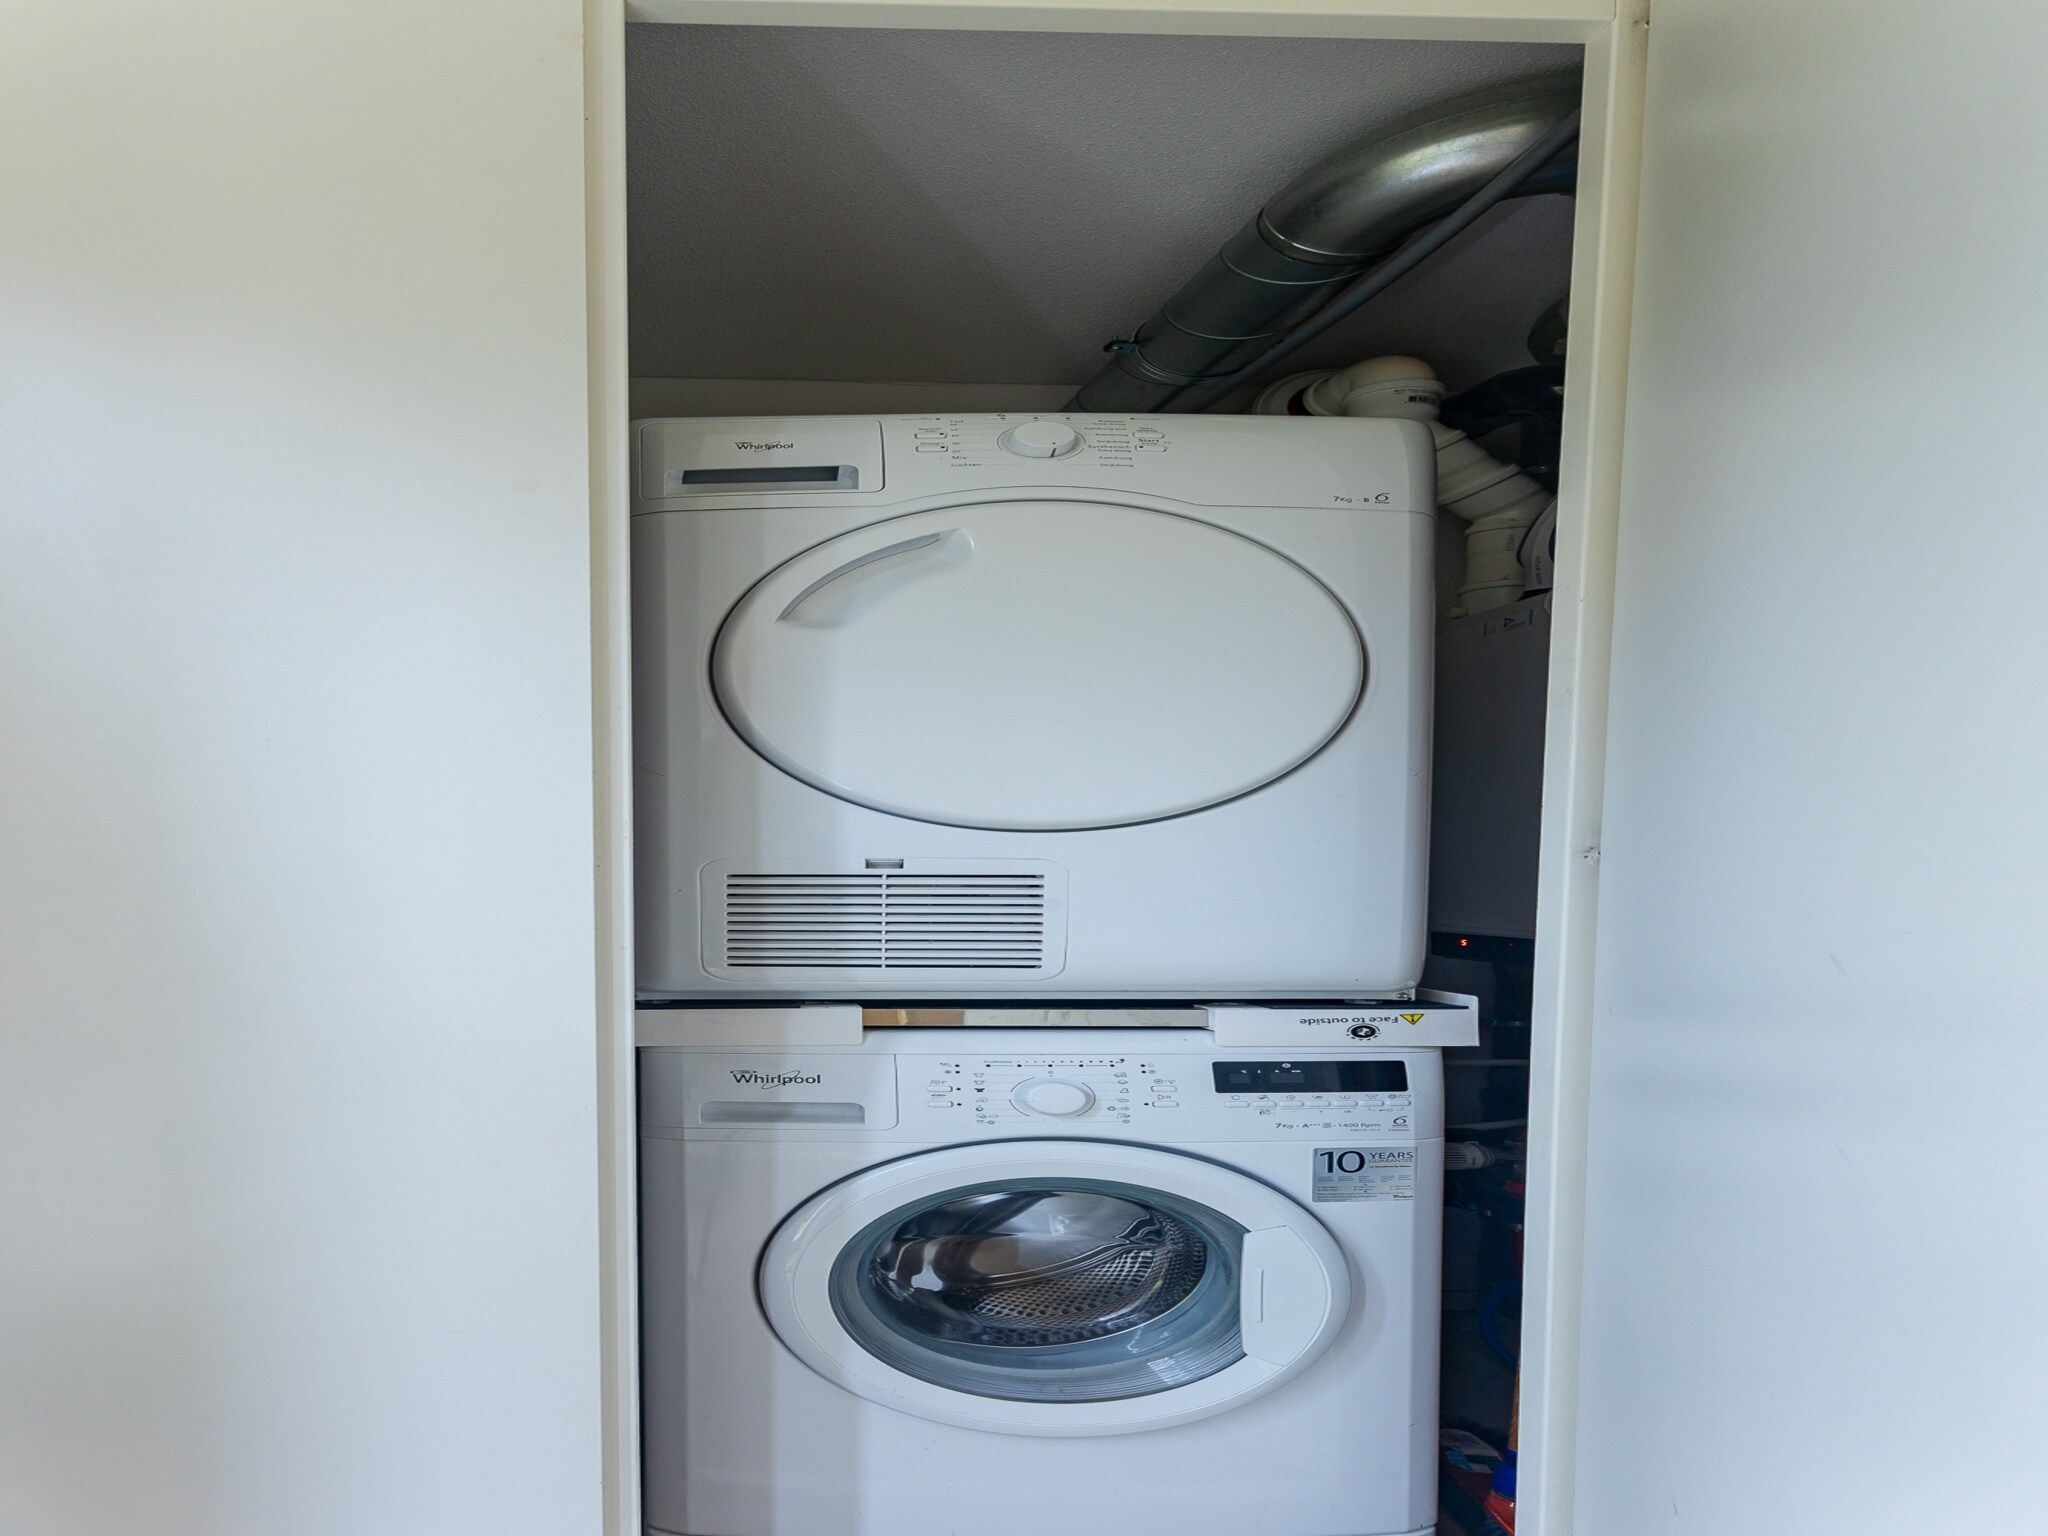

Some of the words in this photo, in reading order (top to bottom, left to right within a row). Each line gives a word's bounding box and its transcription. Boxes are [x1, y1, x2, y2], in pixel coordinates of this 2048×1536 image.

[735, 441, 794, 452] Whirlpool
[1299, 1017, 1348, 1026] outside
[1368, 1016, 1399, 1024] Face
[732, 1071, 821, 1087] Whirlpool
[1318, 1150, 1366, 1174] 10
[1369, 1151, 1414, 1160] YEARS
